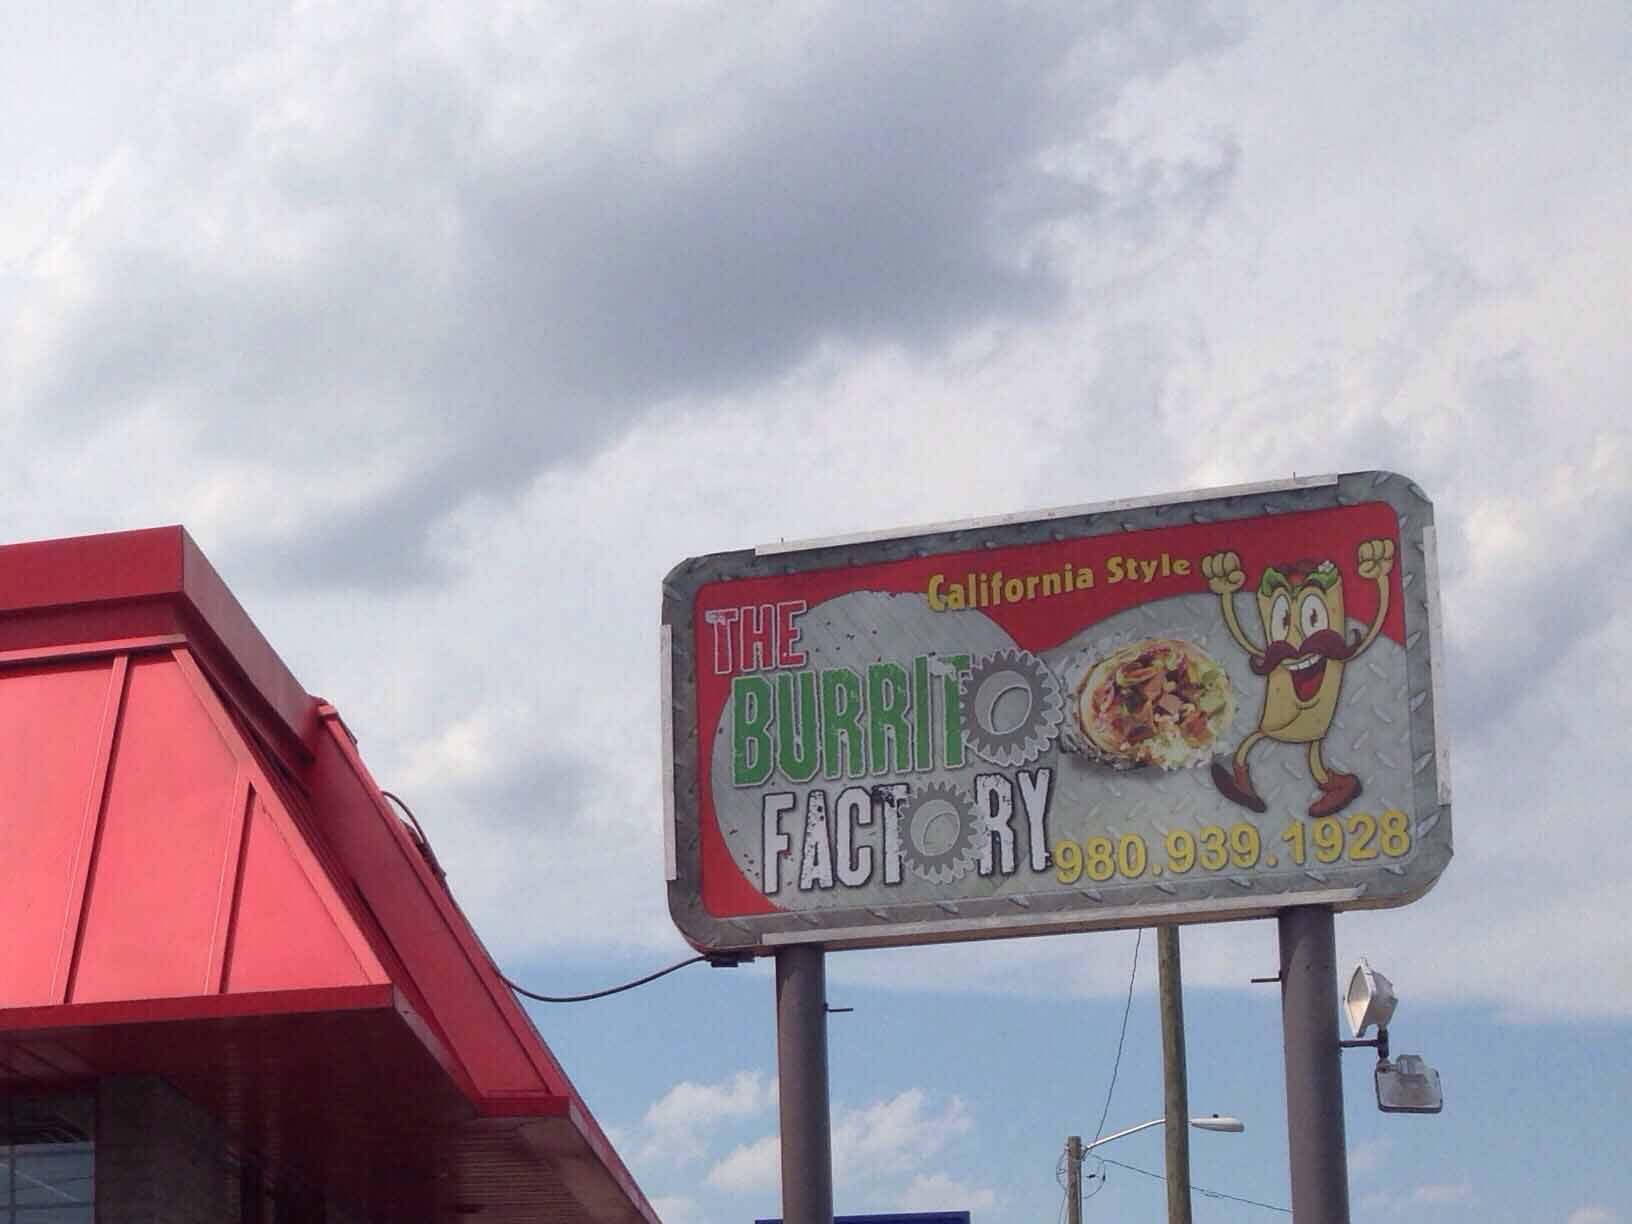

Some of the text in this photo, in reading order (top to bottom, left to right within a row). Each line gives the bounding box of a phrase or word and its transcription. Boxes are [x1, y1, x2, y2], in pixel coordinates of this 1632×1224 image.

[927, 553, 1191, 612] California Style
[705, 600, 808, 676] THE
[731, 648, 1066, 788] BURRITO
[762, 767, 1054, 895] FACTORY
[1054, 809, 1411, 885] 980.939.1928
